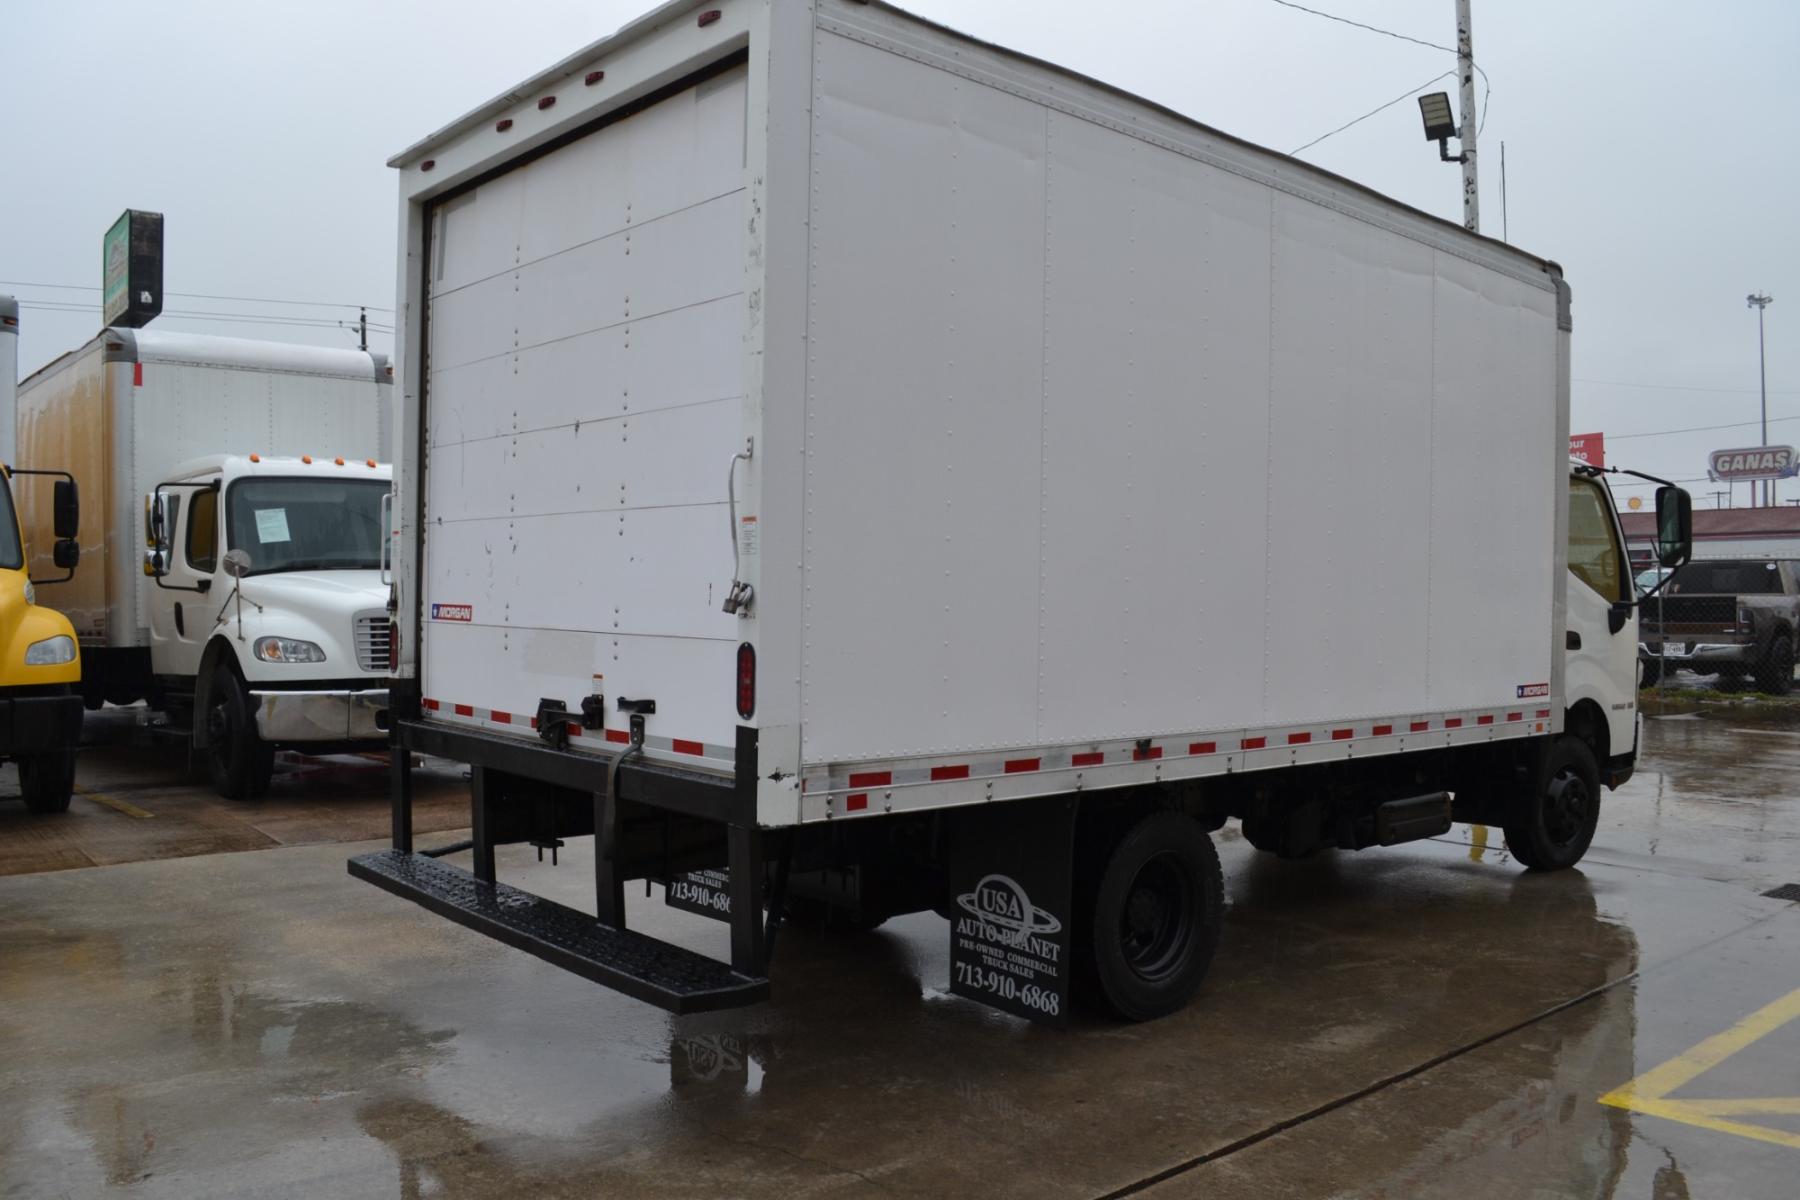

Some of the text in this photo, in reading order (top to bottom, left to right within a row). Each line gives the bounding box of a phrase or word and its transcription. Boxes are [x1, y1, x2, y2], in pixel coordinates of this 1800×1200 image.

[1716, 451, 1788, 472] GANAS
[438, 606, 471, 620] MORGAN
[982, 888, 1022, 919] USA
[959, 938, 1058, 977] PRE-OWNED COMMERCIAL
[982, 955, 1034, 979] TRUCK SALES
[956, 961, 1059, 1016] 713-910-6868
